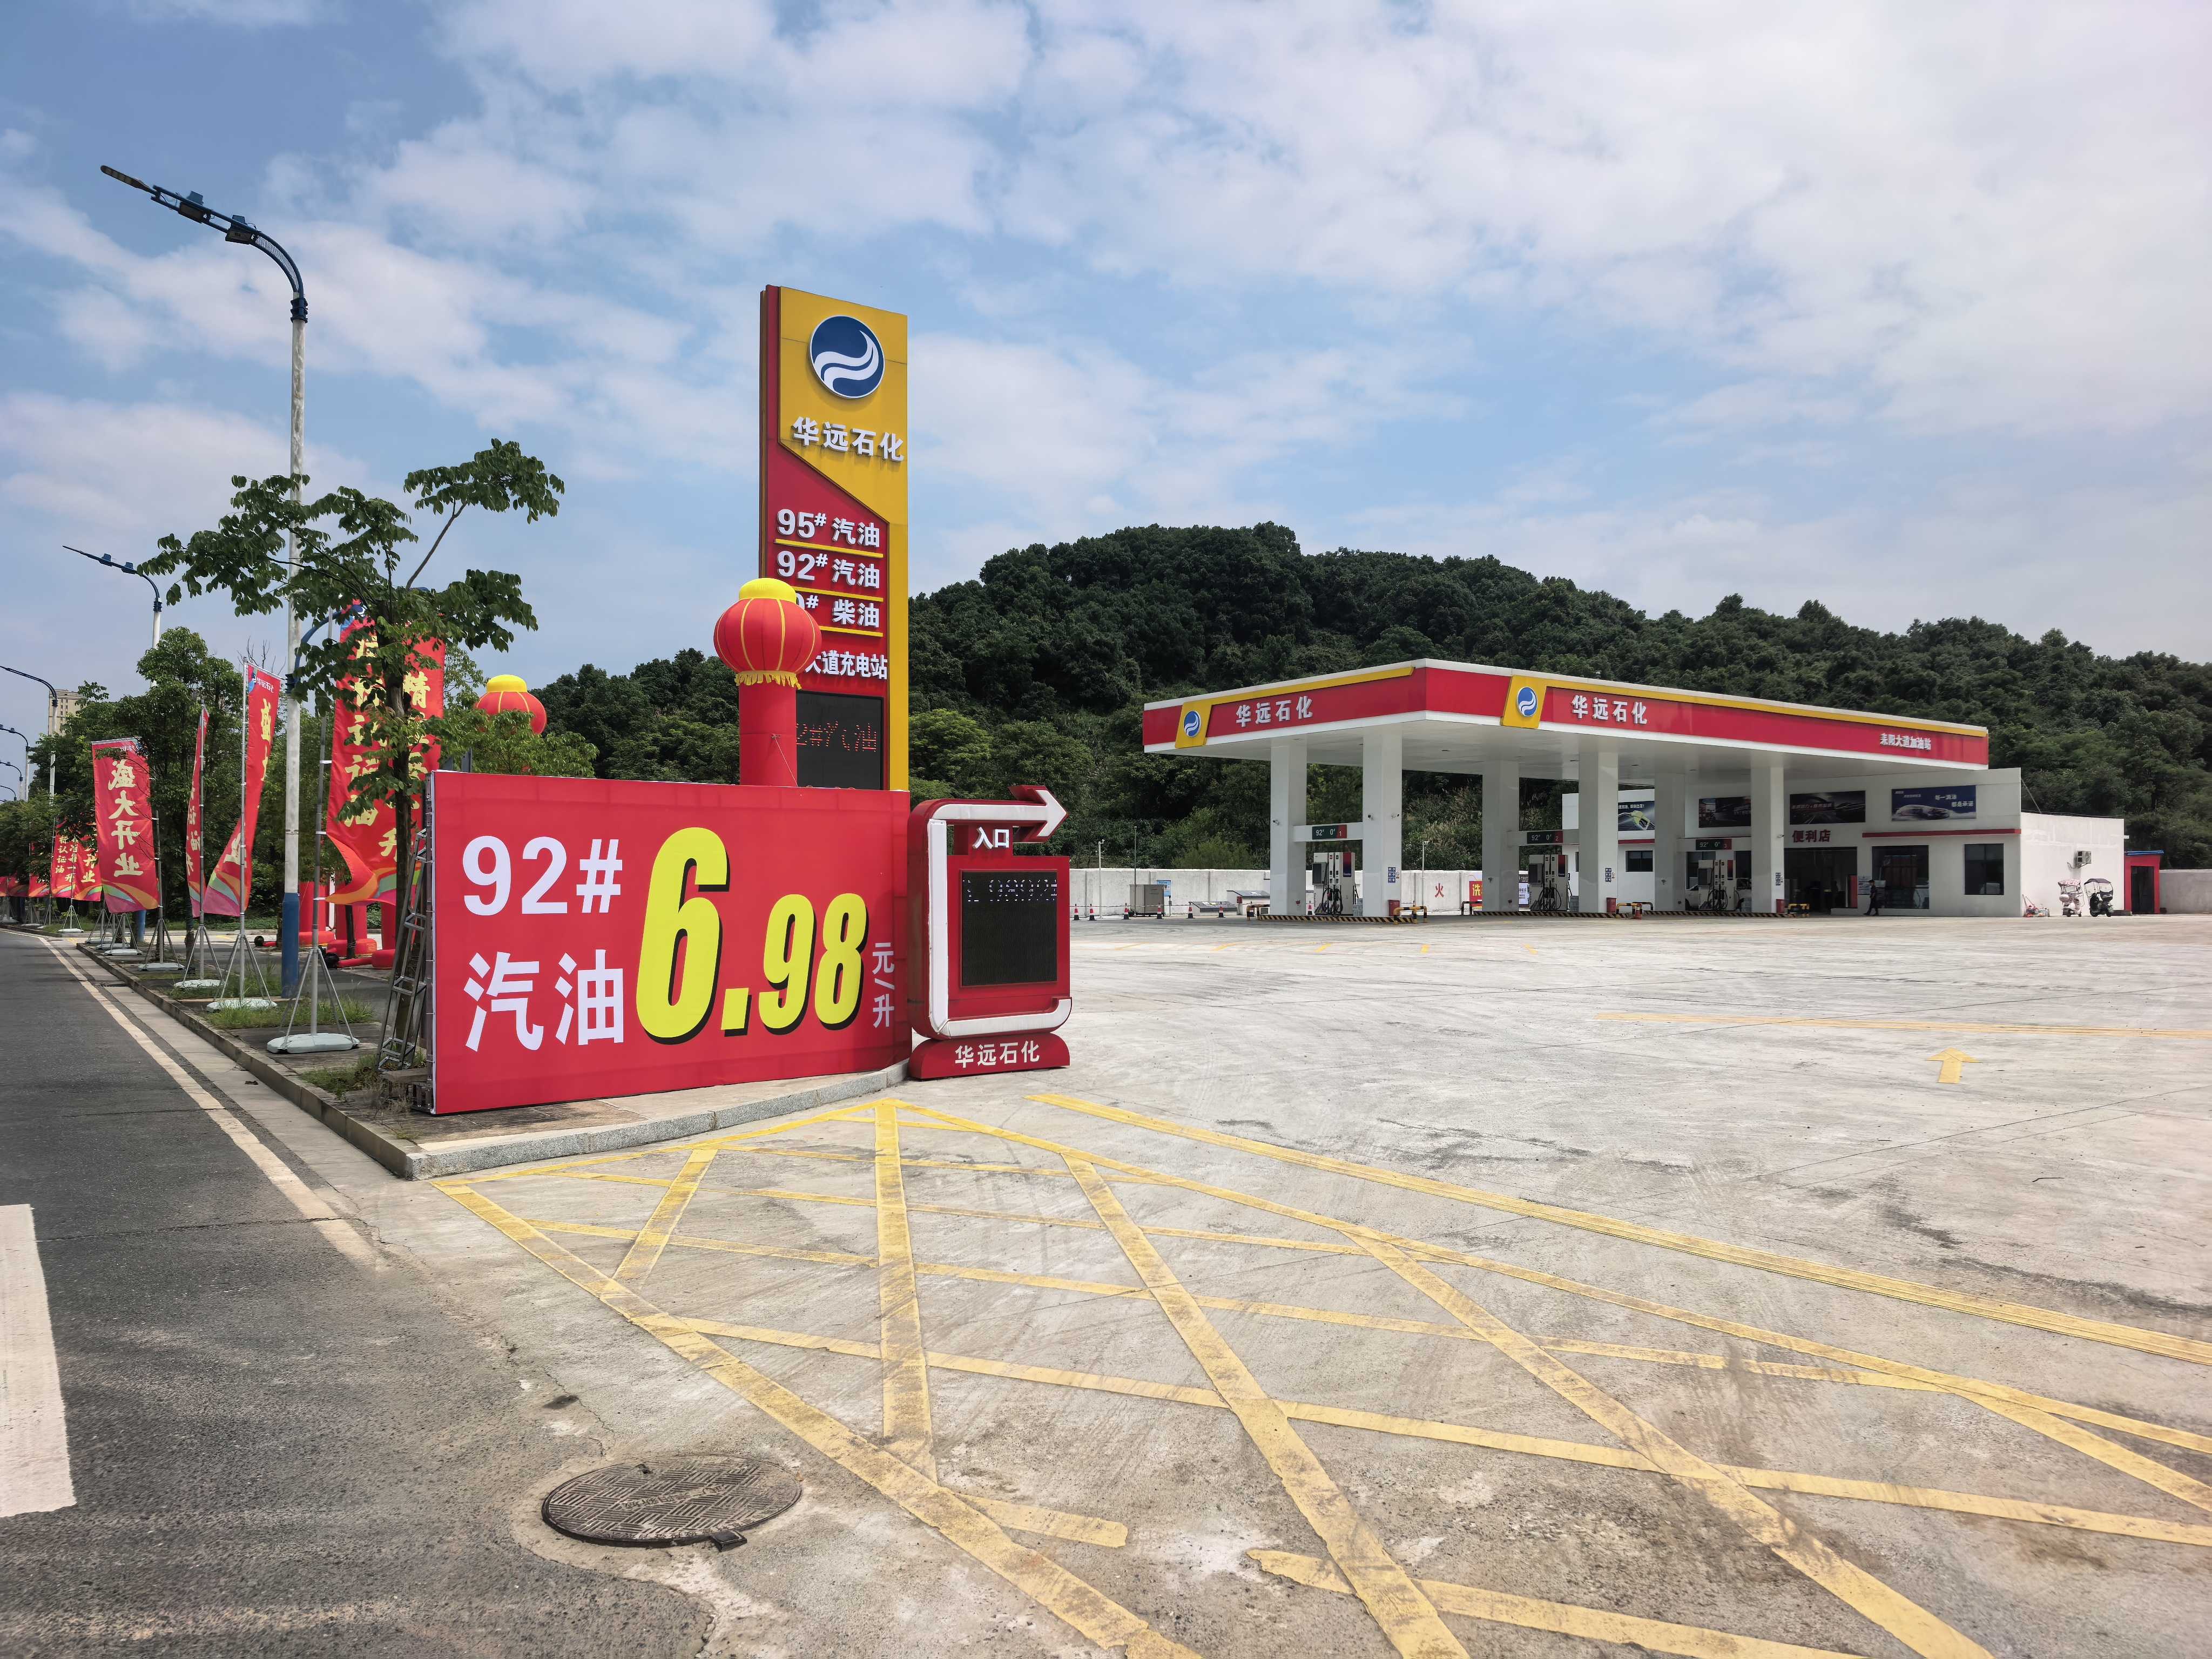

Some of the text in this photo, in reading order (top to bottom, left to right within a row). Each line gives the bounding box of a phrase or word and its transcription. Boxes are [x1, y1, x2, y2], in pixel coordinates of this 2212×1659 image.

[792, 416, 904, 462] 华远石化
[777, 509, 880, 548] 95# 汽油
[777, 550, 880, 589] 92# 汽油
[832, 599, 879, 628] 柴油
[1235, 696, 1313, 727] 华远石化
[1572, 694, 1648, 725] 华远石化
[972, 826, 1009, 849] 入口
[1792, 829, 1831, 843] 便利店
[1434, 882, 1445, 898] 火
[462, 827, 871, 1045] 92# 6.98
[463, 949, 624, 1052] 汽油
[872, 942, 895, 1028] 元/升
[954, 1040, 1040, 1069] 华远石化
